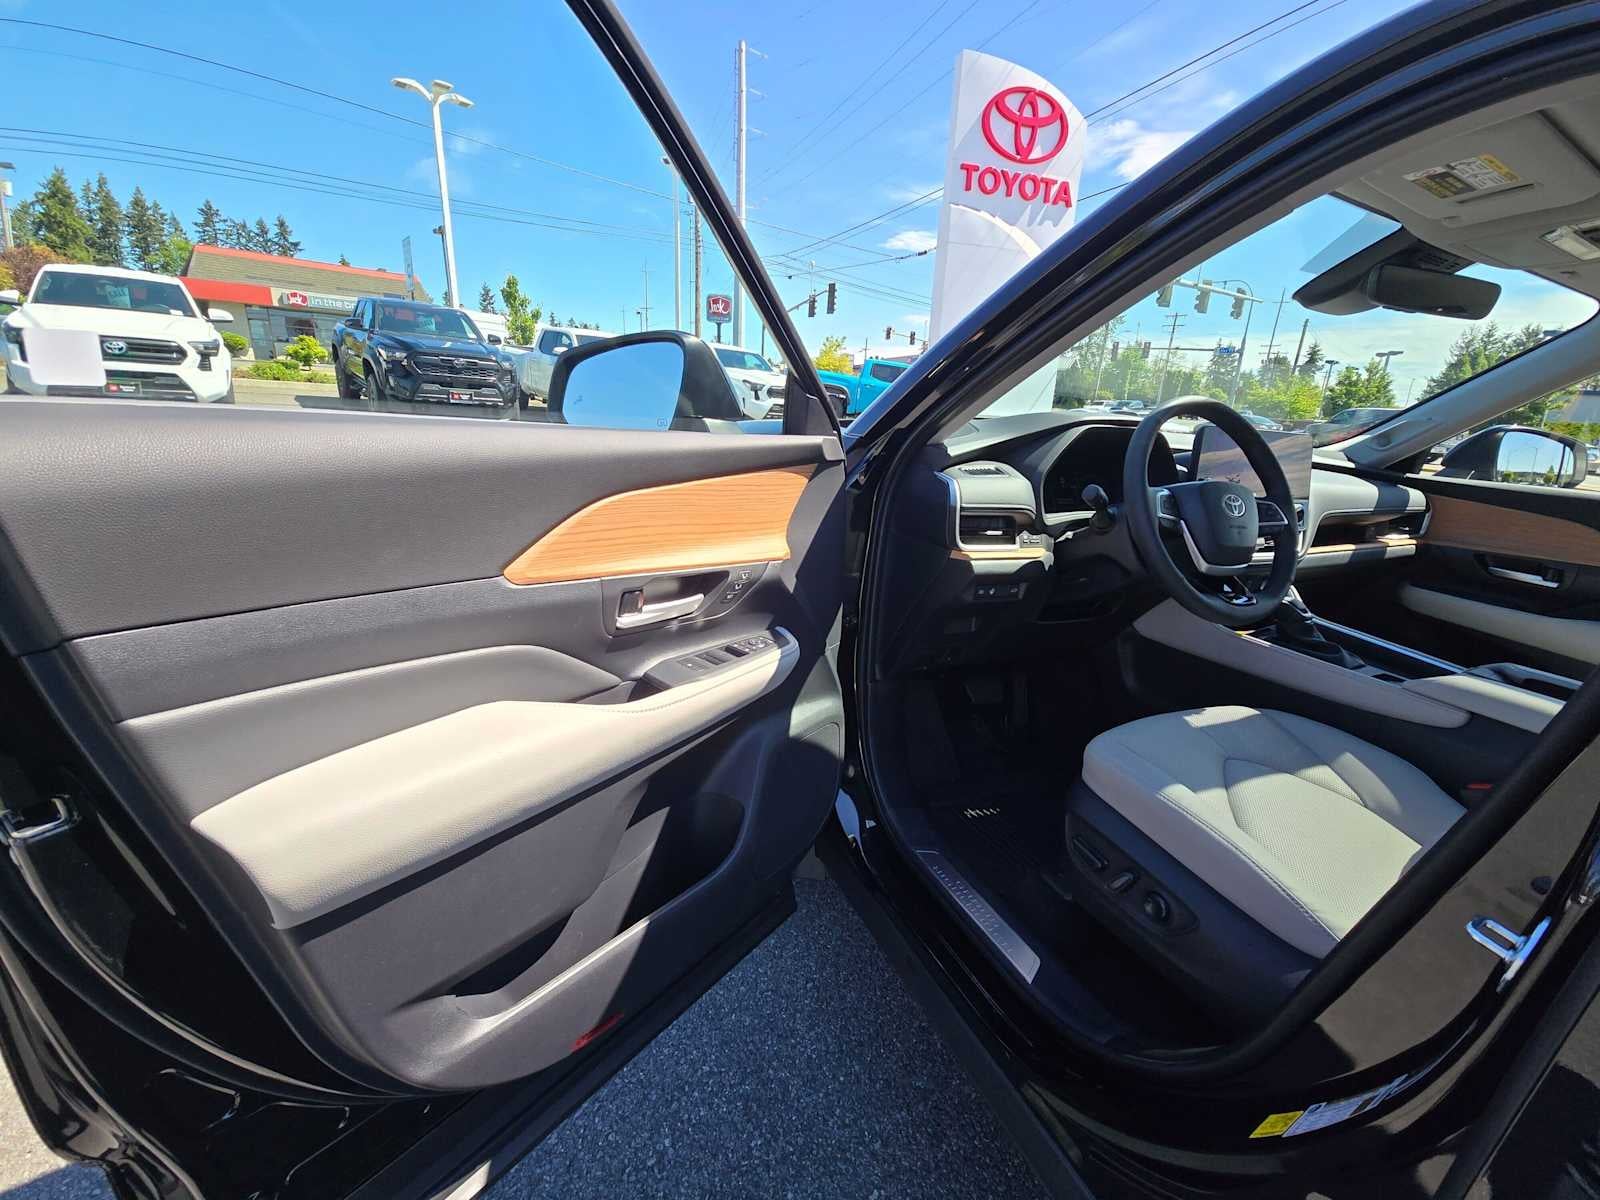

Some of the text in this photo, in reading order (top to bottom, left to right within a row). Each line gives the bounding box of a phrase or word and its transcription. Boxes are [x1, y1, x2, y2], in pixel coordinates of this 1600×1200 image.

[960, 163, 1072, 208] TOYOTA
[311, 296, 321, 305] in
[324, 298, 343, 308] the
[708, 298, 730, 314] Jack
